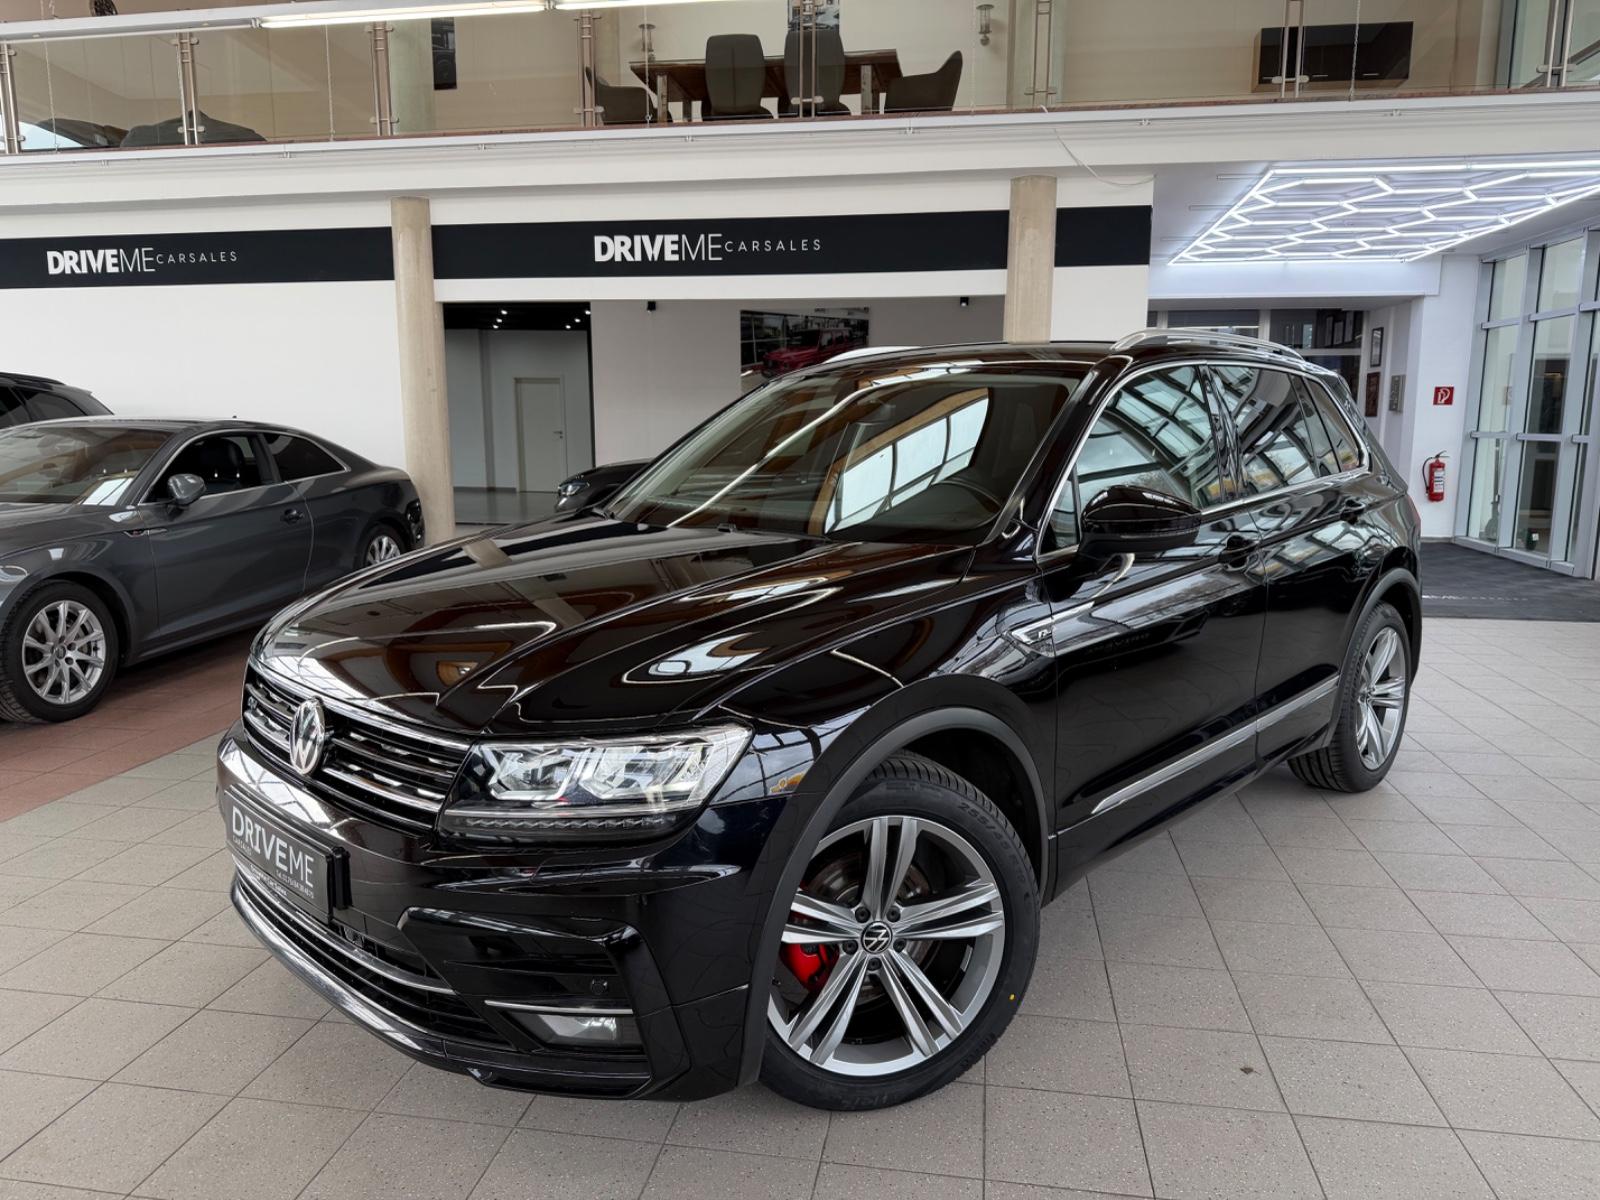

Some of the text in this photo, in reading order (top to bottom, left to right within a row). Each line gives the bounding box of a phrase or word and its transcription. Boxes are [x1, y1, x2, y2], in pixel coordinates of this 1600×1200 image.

[46, 247, 238, 275] DRIVEME CARSALES
[593, 233, 821, 262] DRIVEME CARSALES
[232, 805, 315, 889] DRIVEME
